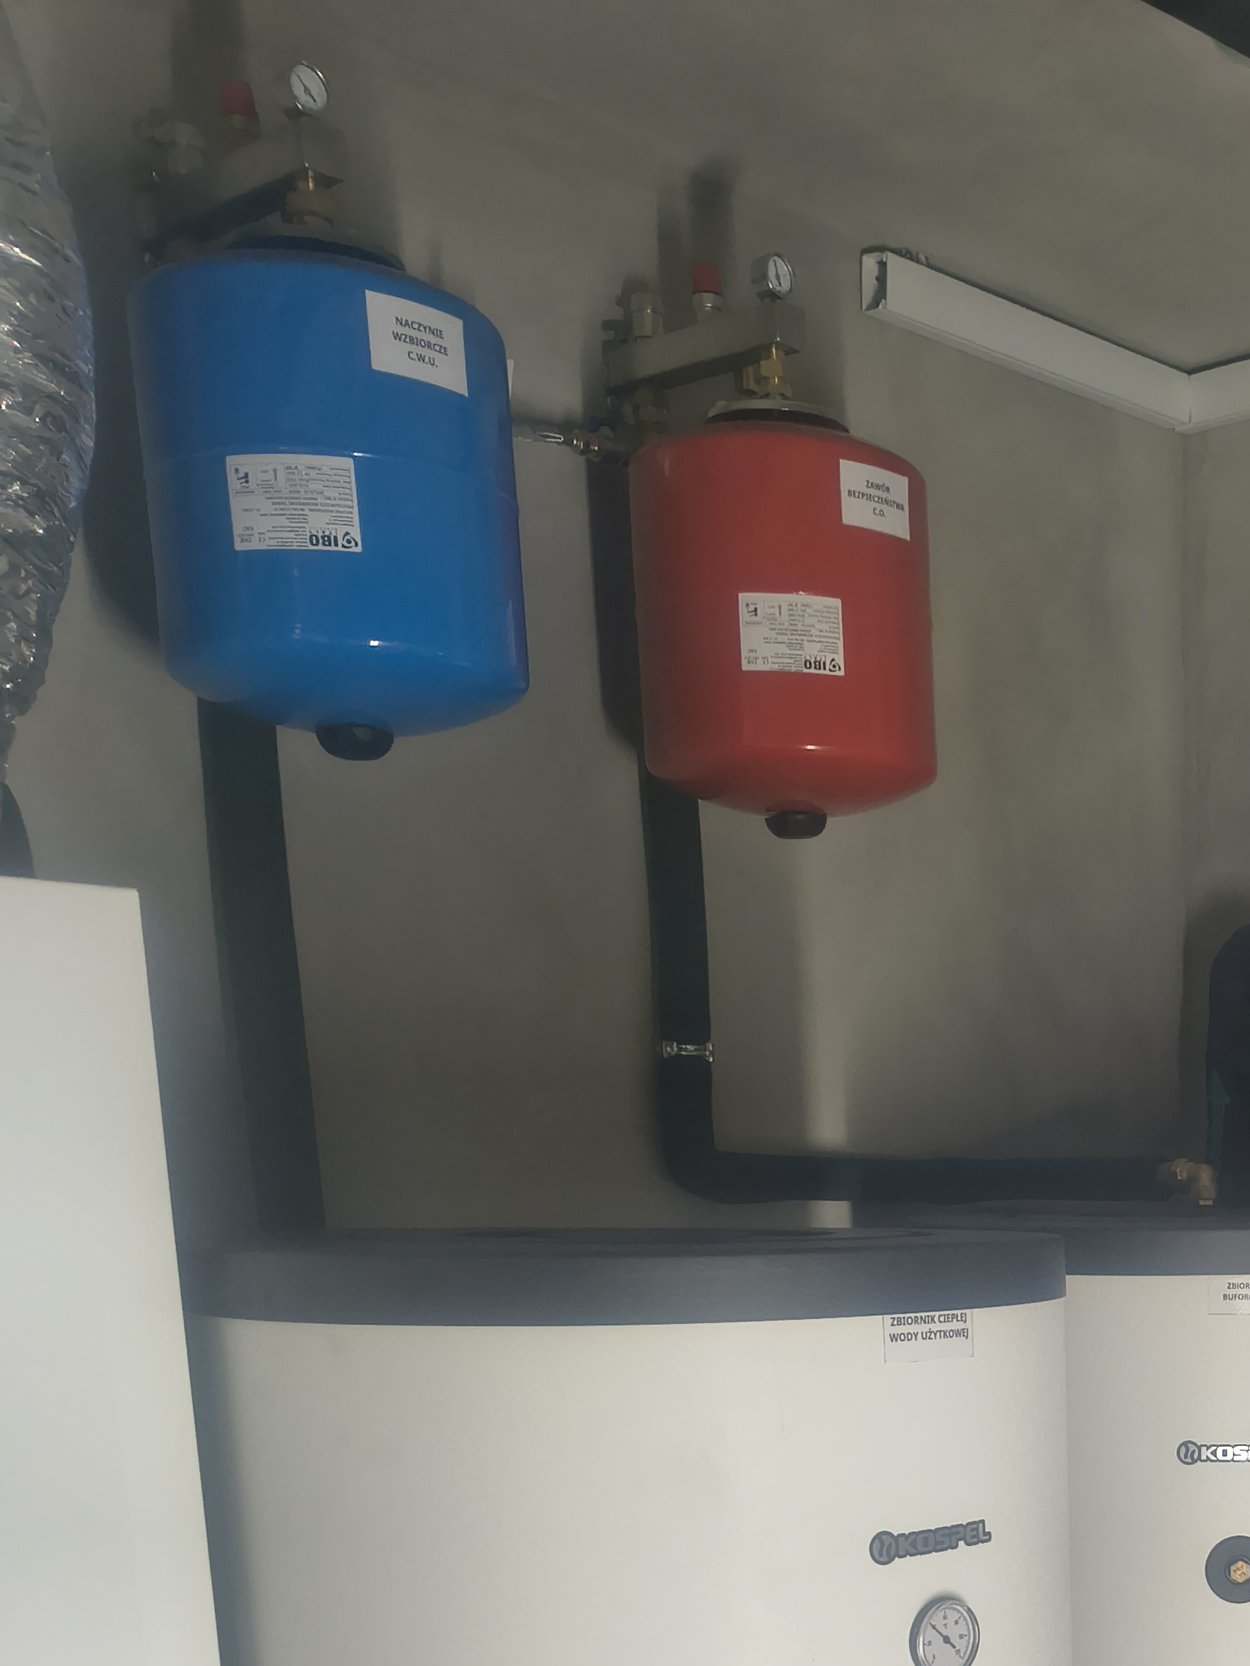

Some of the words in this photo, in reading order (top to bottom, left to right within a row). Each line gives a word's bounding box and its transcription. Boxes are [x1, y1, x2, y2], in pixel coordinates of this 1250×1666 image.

[395, 316, 444, 339] NACZYNIE
[392, 330, 448, 356] WZBIORCZE
[407, 350, 438, 368] C.W.U.
[865, 480, 891, 494] ZAWÓR
[847, 489, 904, 512] BEZPIECZEŃSTWA
[308, 534, 338, 547] IBO
[804, 659, 827, 671] IBO
[890, 1314, 936, 1327] ZBIORNIK
[938, 1312, 967, 1324] CIEPŁEJ
[889, 1331, 919, 1342] WODY
[921, 1328, 969, 1340] UŻYTKOWEJ
[896, 1519, 992, 1558] KOSPEL
